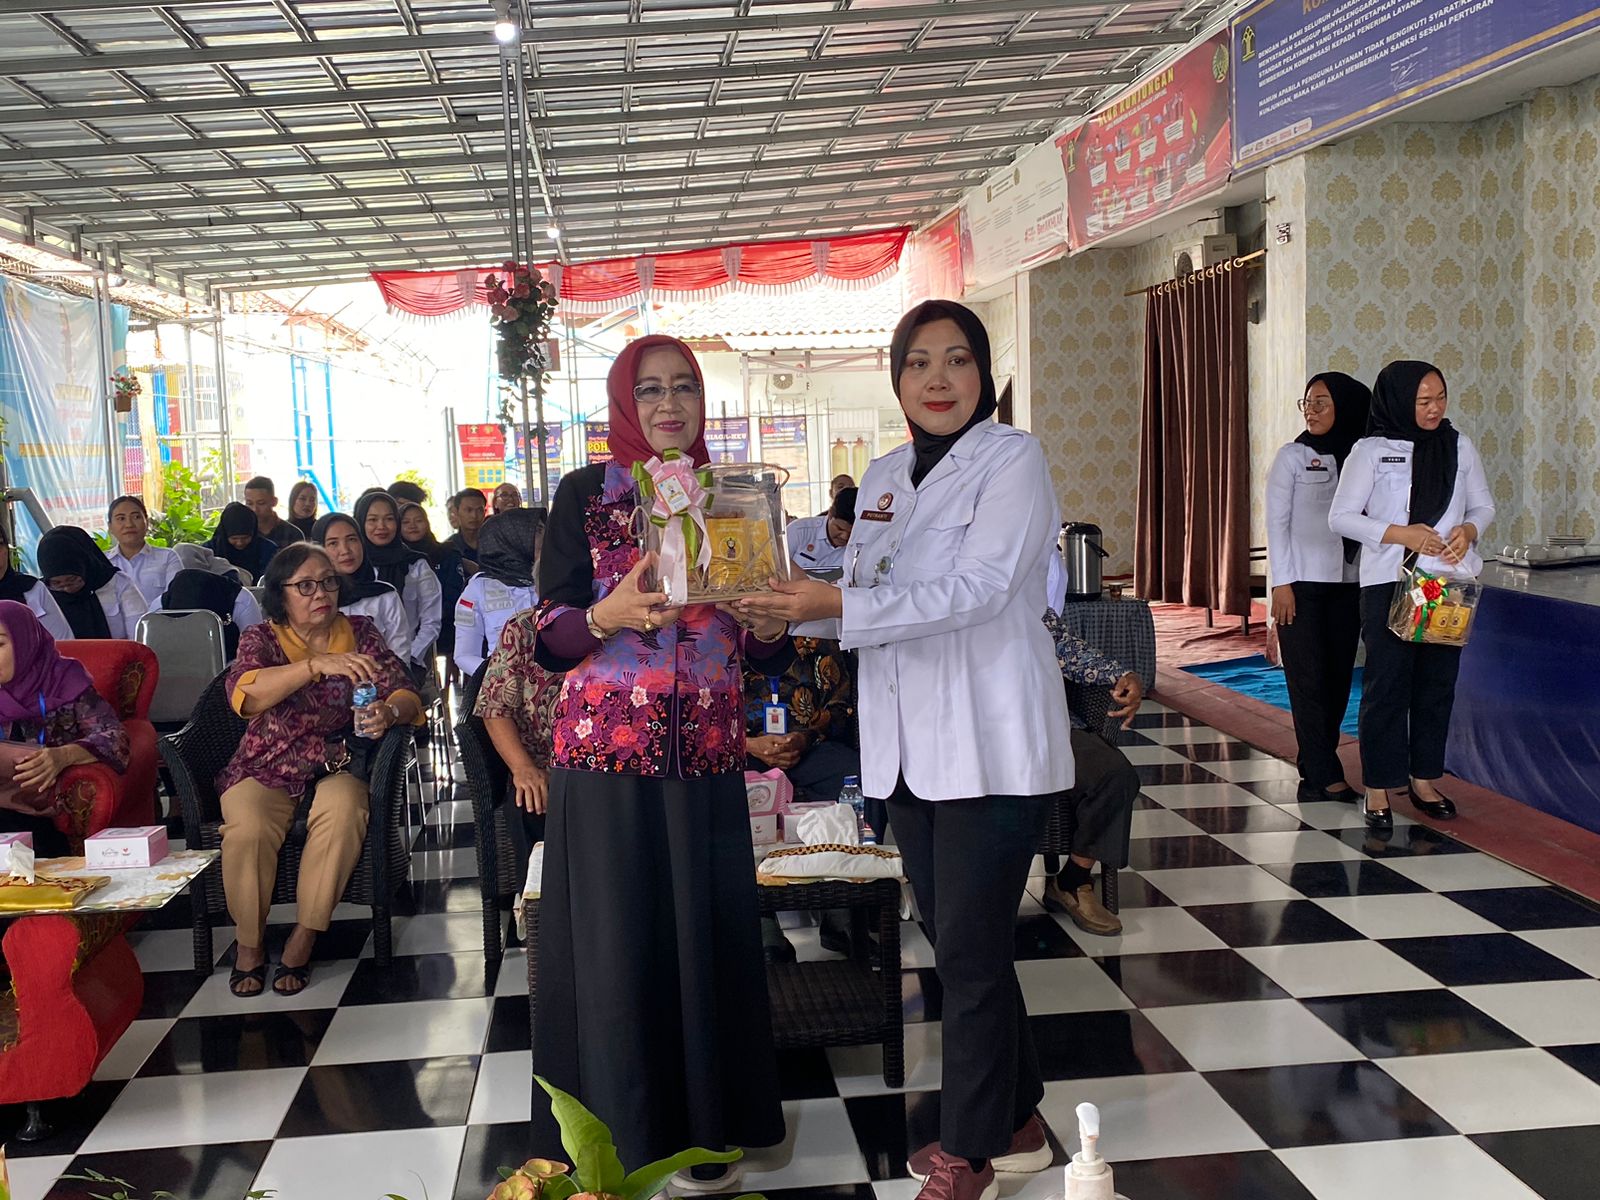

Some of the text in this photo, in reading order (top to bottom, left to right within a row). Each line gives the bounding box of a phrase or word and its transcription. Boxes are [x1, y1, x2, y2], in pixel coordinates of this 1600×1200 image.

[1258, 41, 1280, 59] DENGAN
[1280, 37, 1288, 46] INI
[1289, 30, 1303, 42] KAMI
[1304, 12, 1331, 33] SELURUH
[1258, 45, 1293, 68] MENYATAKAN
[1294, 29, 1321, 49] SANGGUP
[1258, 61, 1282, 78] STANDAR
[1283, 43, 1315, 65] PELAYANAN
[1315, 34, 1332, 47] YANG
[1333, 22, 1353, 37] TELAH
[1258, 65, 1293, 88] MEMBERIKAN
[1294, 45, 1330, 69] KOMPENSASI
[1331, 32, 1356, 49] KEPADA
[1357, 13, 1391, 36] PENERIMA
[1258, 93, 1278, 107] NAMUN
[1278, 81, 1301, 98] APABILA
[1301, 65, 1334, 86] PENGGUNA
[1334, 50, 1363, 69] LAYANAN
[1364, 39, 1385, 54] TIDAK
[1386, 17, 1427, 44] MENGIKUTI
[1293, 87, 1310, 99] MAKA
[1310, 80, 1326, 91] KAMI
[1327, 71, 1344, 84] AKAN
[1345, 48, 1389, 75] MEMBERIKAN
[1390, 34, 1417, 53] SANKSI
[1418, 20, 1447, 39] SESUAI
[1097, 107, 1118, 127] ALUR
[1119, 66, 1174, 113] KUNJUNGAN
